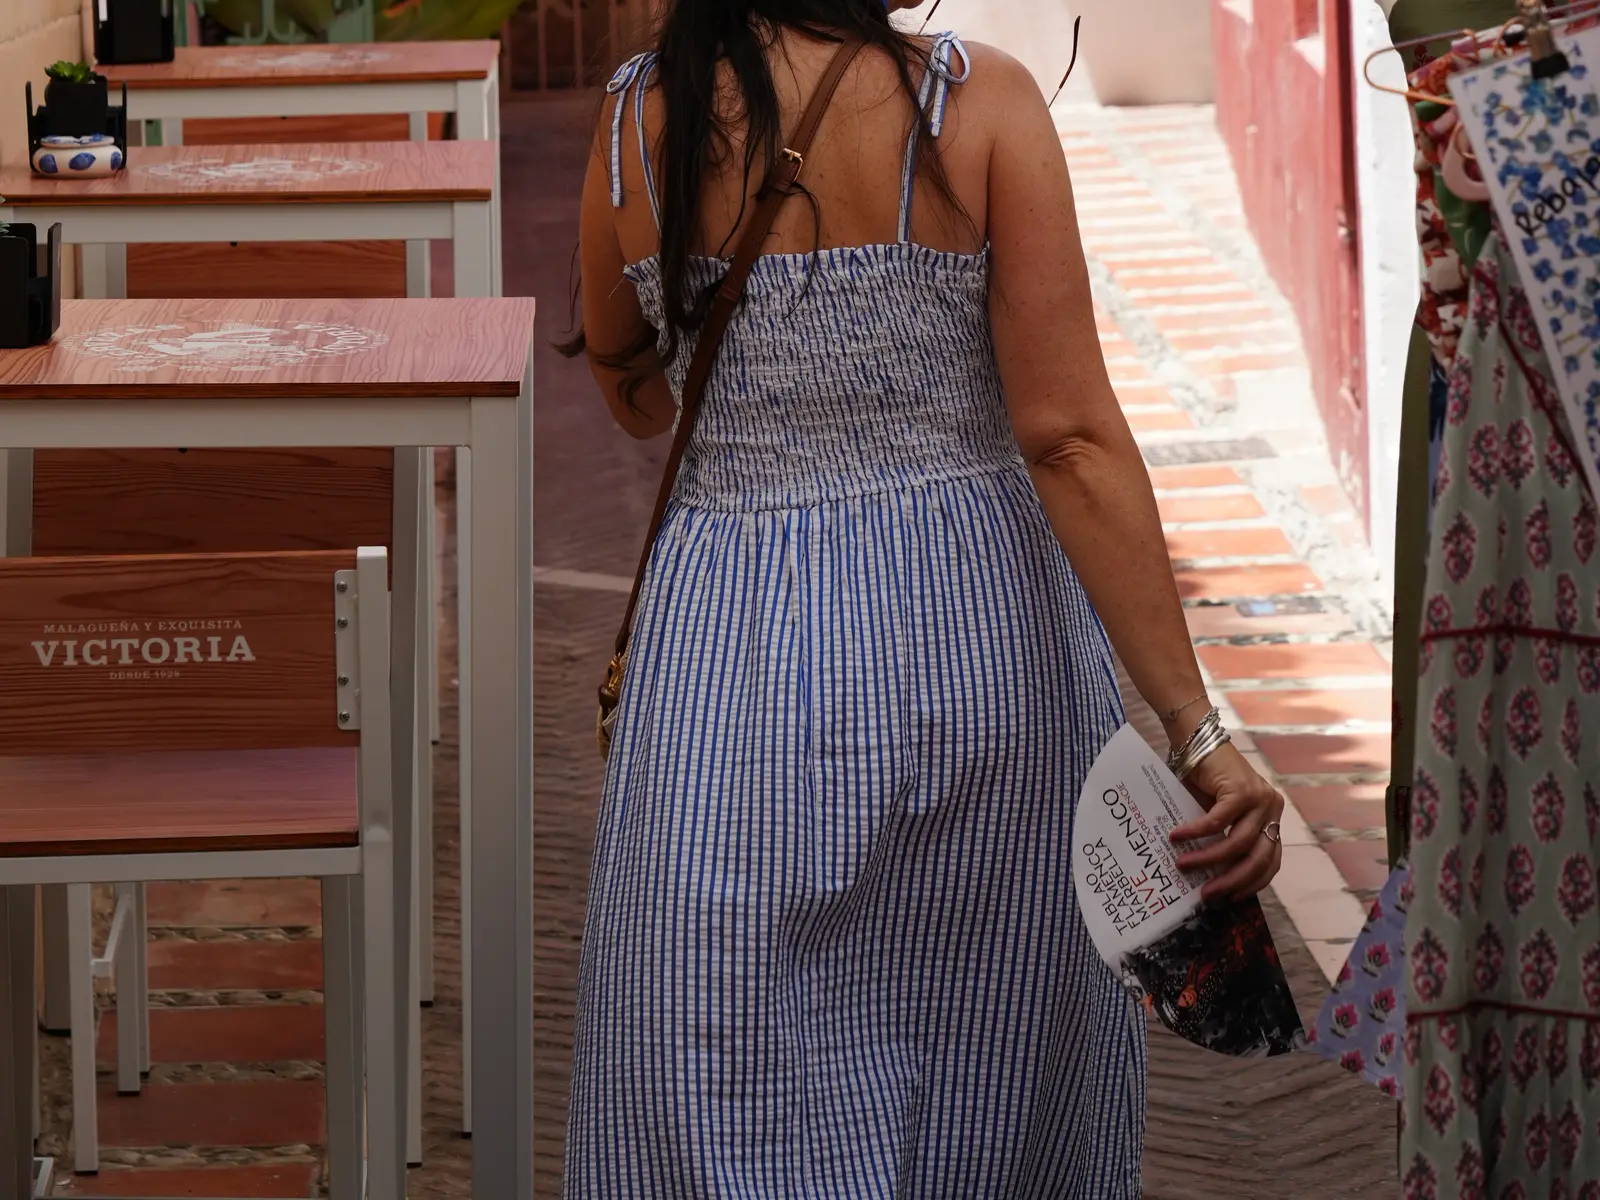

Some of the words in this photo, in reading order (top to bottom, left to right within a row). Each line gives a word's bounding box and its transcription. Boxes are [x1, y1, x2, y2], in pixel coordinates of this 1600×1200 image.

[31, 634, 257, 667] VICTORIA
[43, 621, 140, 634] MALAGUEÑA
[144, 621, 154, 632] Y
[158, 620, 243, 632] EXQUISITA
[109, 671, 151, 680] DESDE
[155, 670, 181, 679] 1928
[1102, 788, 1181, 907] FLAMENCO
[1154, 845, 1190, 896] BOUTIQUE
[1082, 843, 1141, 929] FLAMENCO
[1086, 874, 1127, 937] TABLAO
[1096, 837, 1151, 923] MARBELLA
[1130, 870, 1167, 915] LIVE
